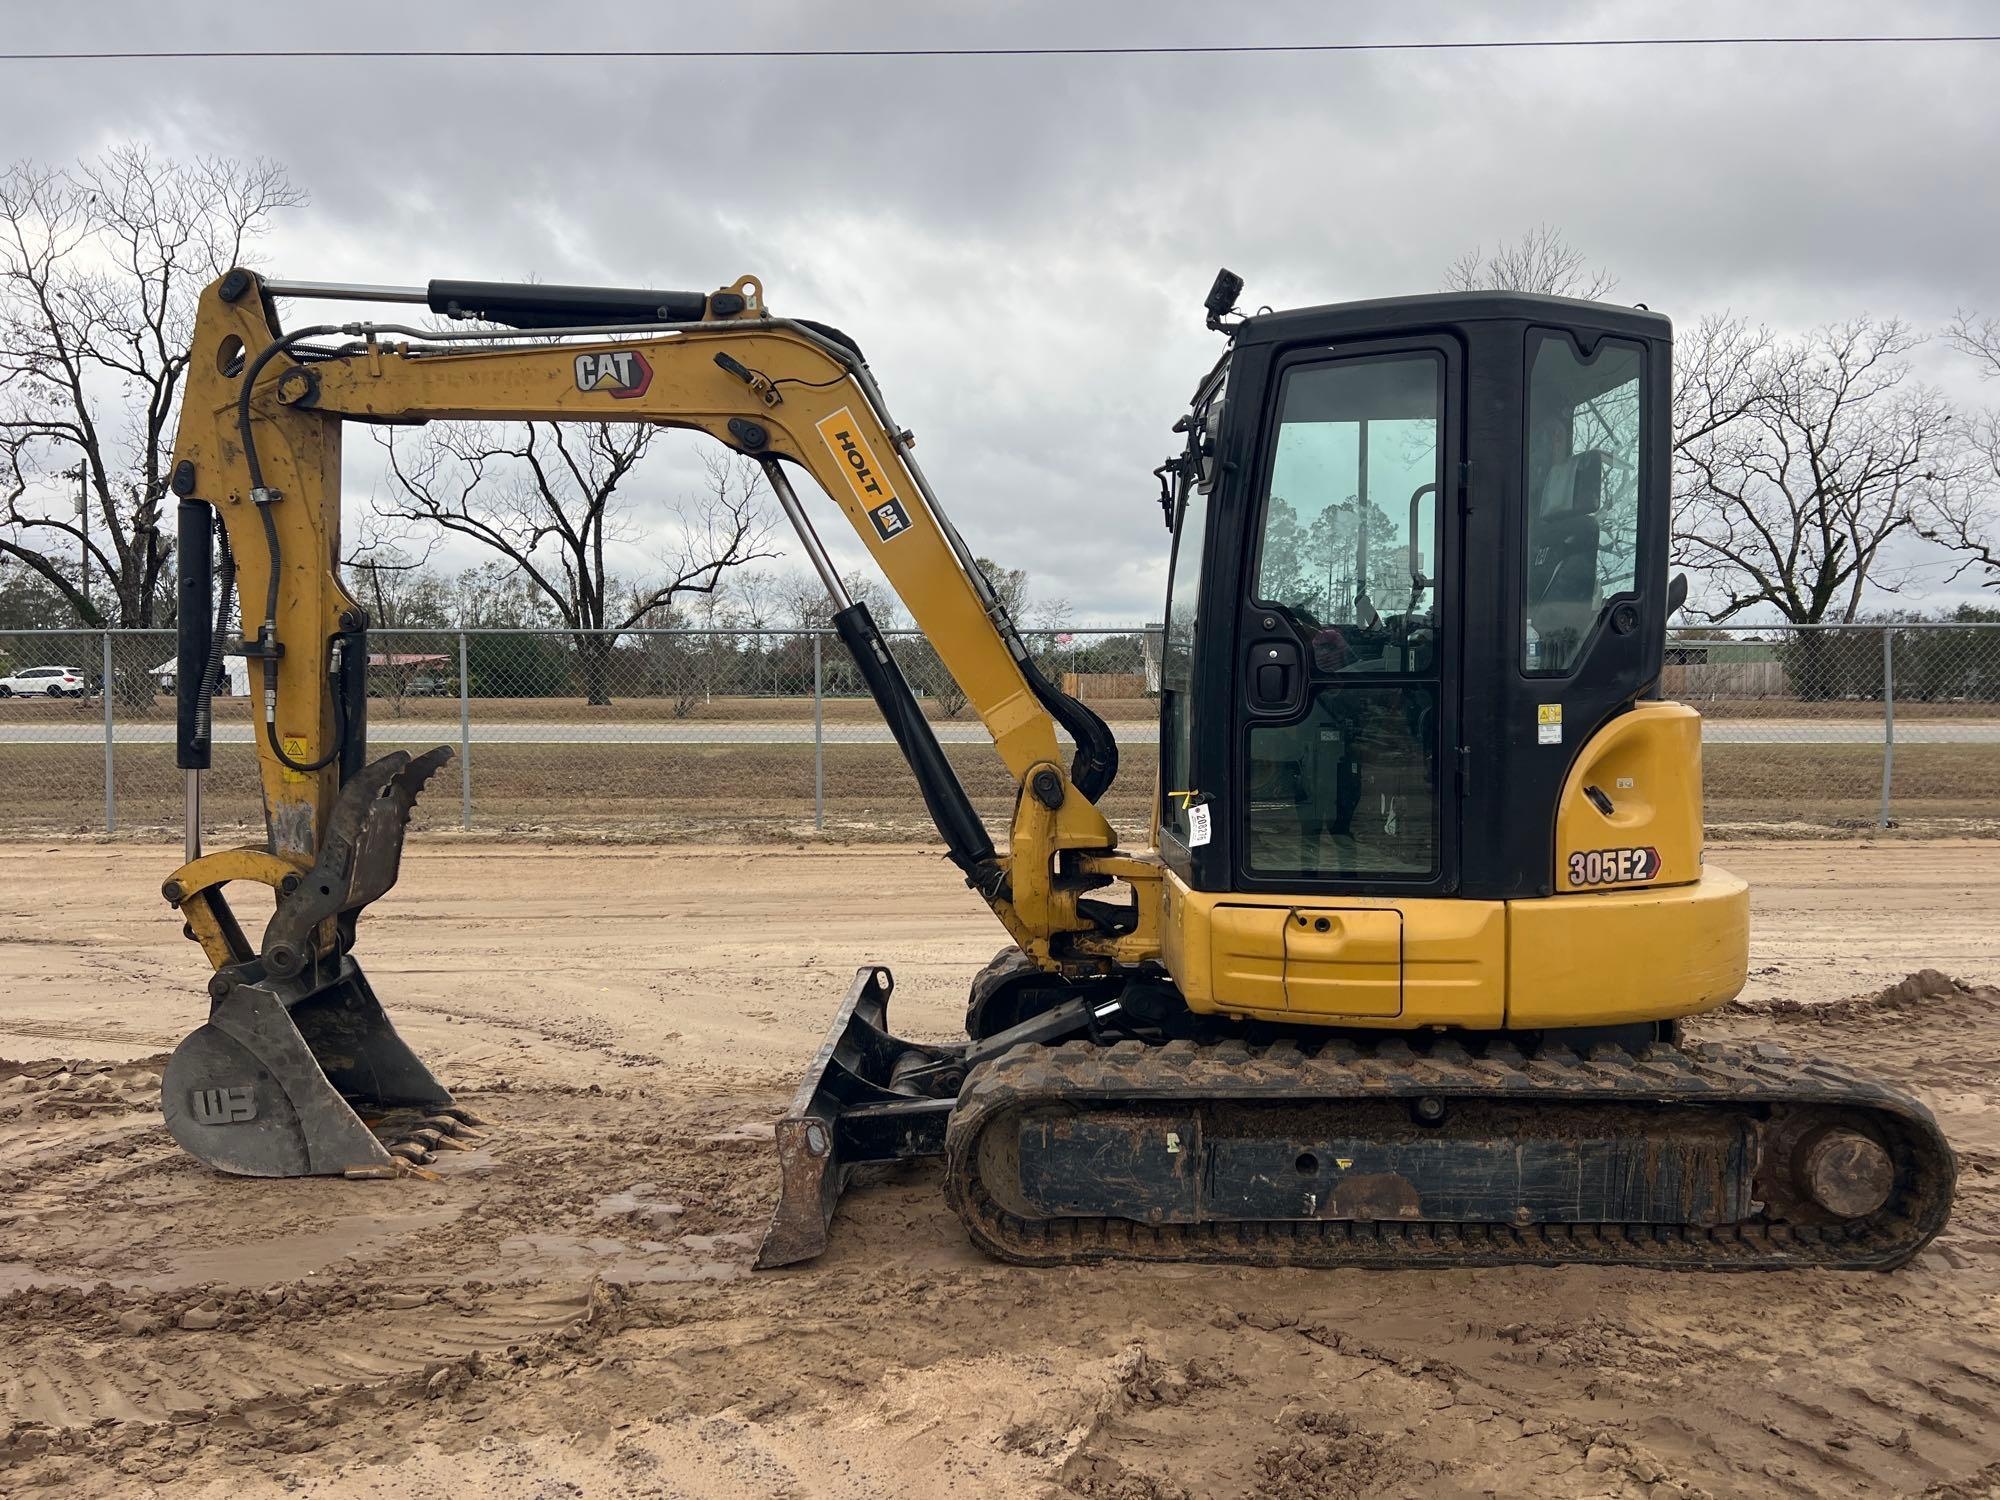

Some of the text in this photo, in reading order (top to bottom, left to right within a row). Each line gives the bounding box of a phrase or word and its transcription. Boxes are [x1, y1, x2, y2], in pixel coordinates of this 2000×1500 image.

[575, 352, 632, 391] CAT
[834, 430, 883, 496] HOLT
[877, 504, 904, 533] CAT
[1569, 848, 1647, 885] 305E2
